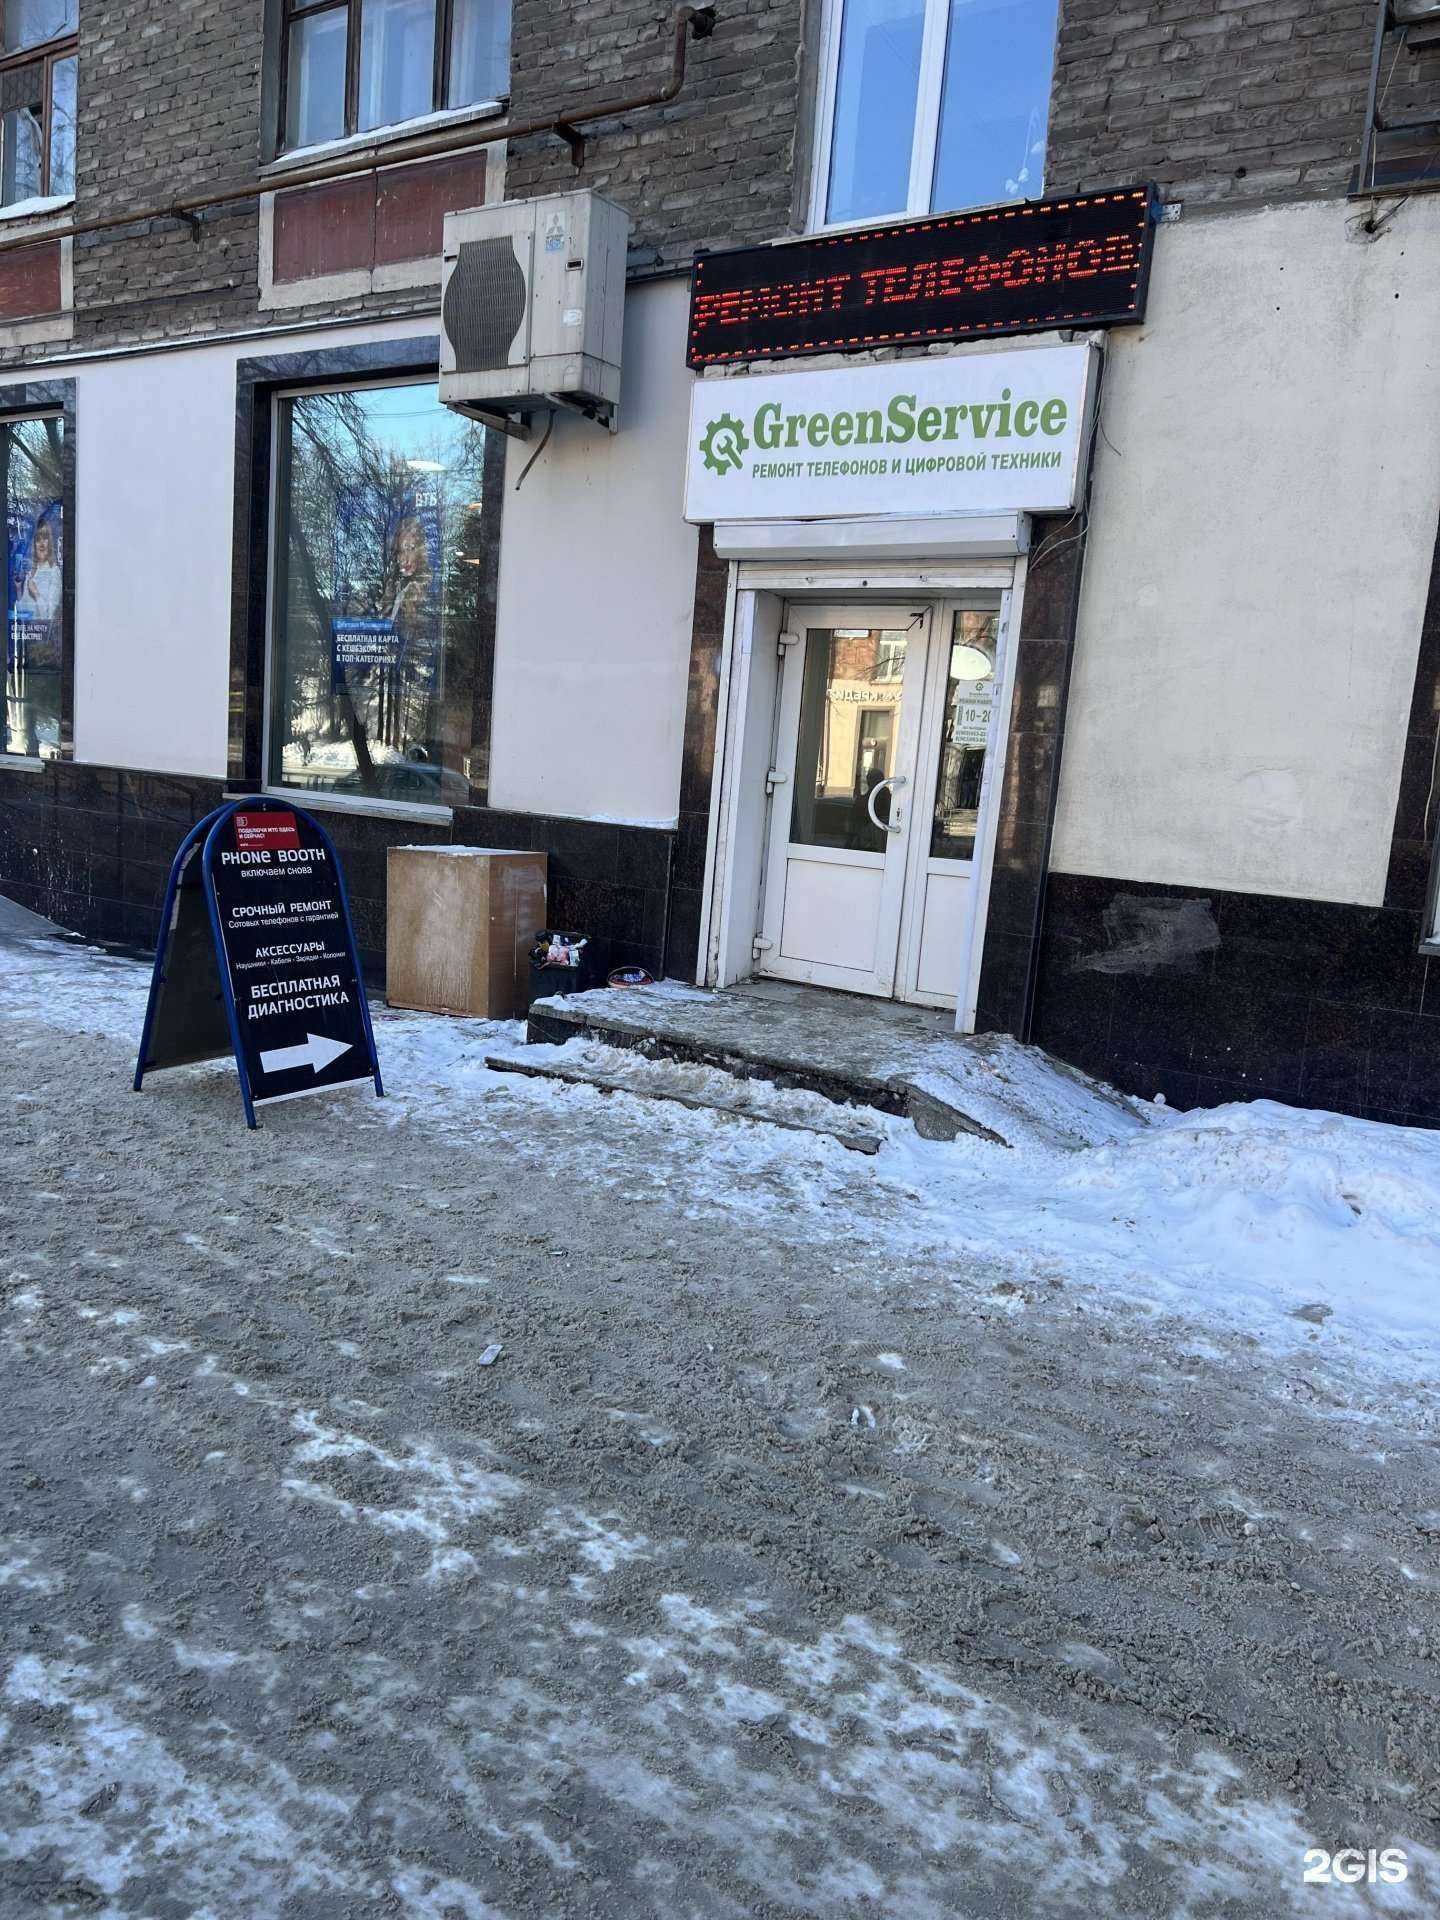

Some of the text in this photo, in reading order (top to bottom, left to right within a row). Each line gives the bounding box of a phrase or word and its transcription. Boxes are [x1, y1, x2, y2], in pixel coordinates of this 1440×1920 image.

[696, 234, 1131, 326] РЕМОНТ ТЕЛЕФОНОВ
[752, 388, 1067, 449] GreenService
[752, 451, 1062, 478] РЕМОНТ ТЕЛЕФОНОВ И ЦИФРОВОЙ ТЕХНИКИ
[336, 634, 399, 643] БЕСПЛАТНАЯ КАРТА
[342, 654, 397, 664] ТОП-КАТЕГОРИЯХ
[278, 849, 326, 862] BOOTH
[241, 866, 313, 878] включаем снова
[232, 900, 332, 918] СРОЧНЫЙ РЕМОНТ
[228, 920, 260, 929] Сотовых
[261, 915, 299, 925] телефонов
[305, 911, 339, 922] гарантией
[255, 941, 325, 958] АКСЕССУАРЫ
[236, 960, 267, 971] Наушники
[271, 956, 292, 966] Кабели
[251, 975, 340, 999] БЕСПЛАТНАЯ
[248, 991, 350, 1020] ДИАГНОСТИКА
